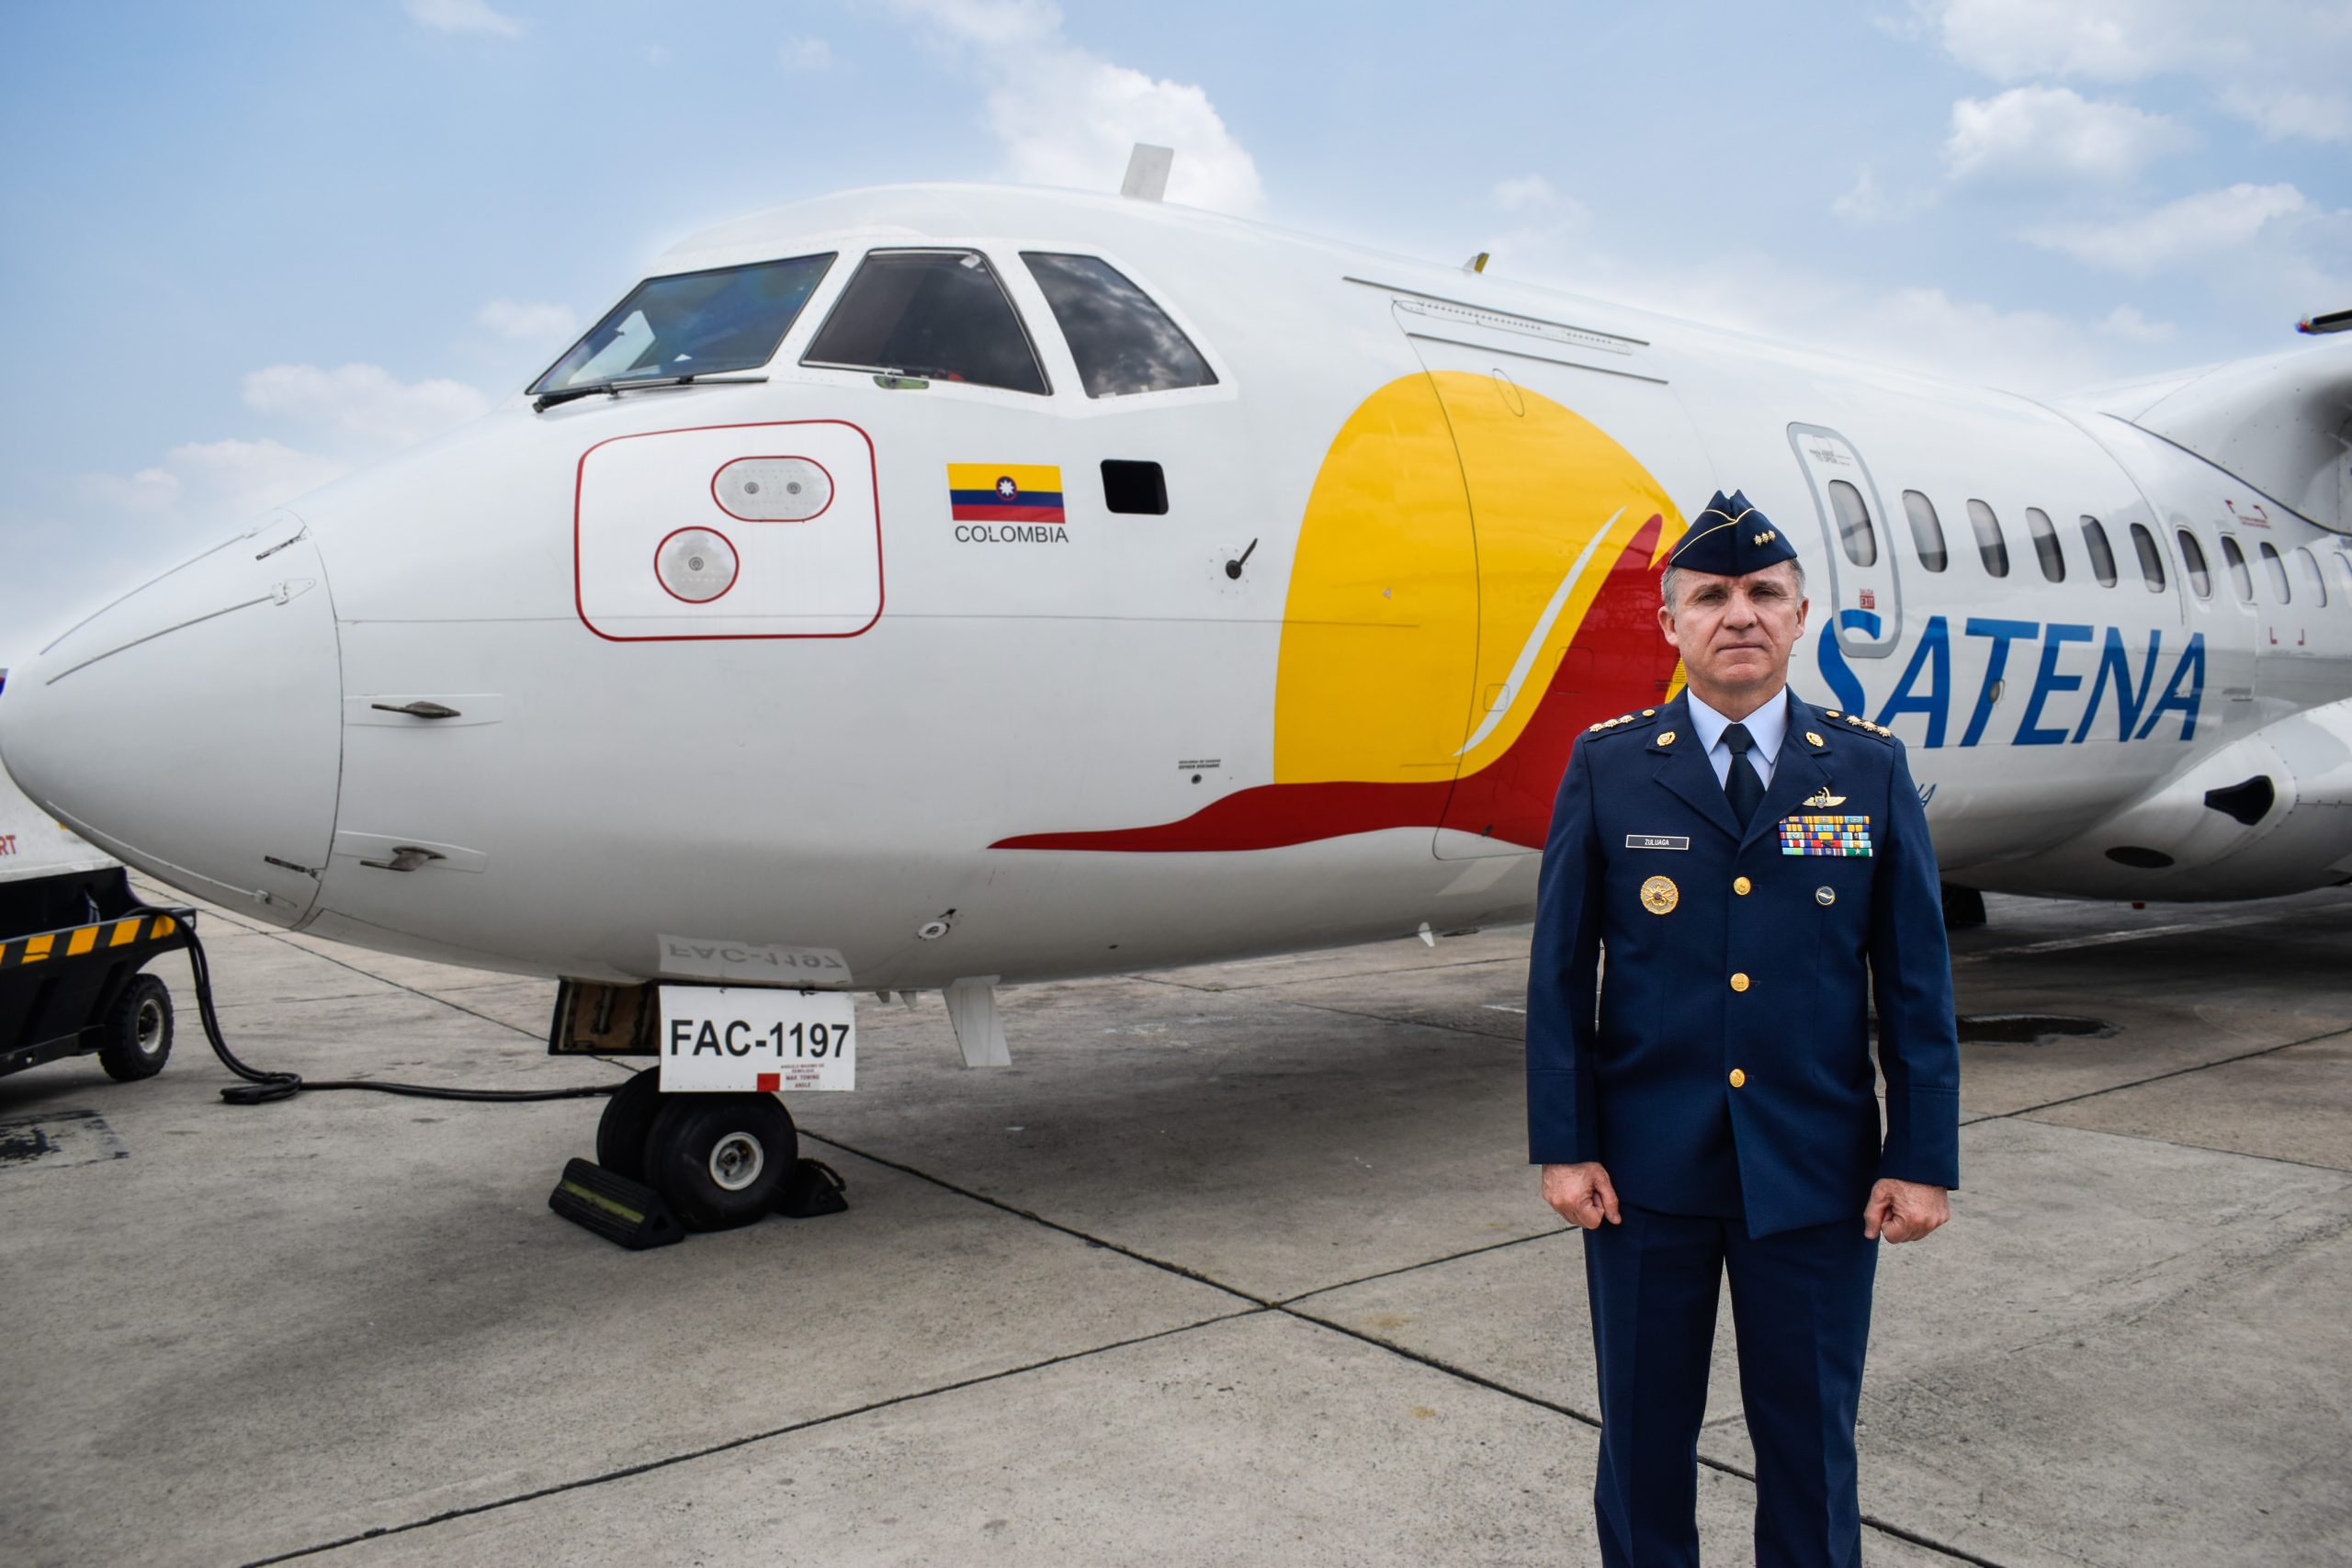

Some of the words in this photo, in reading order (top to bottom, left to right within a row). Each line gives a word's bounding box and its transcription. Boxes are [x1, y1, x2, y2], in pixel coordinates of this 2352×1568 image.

[955, 525, 1069, 544] COLOMBIA
[1816, 608, 2206, 750] SATENA
[1644, 838, 1670, 846] ZULUAGA
[670, 1019, 851, 1058] FAC-1197
